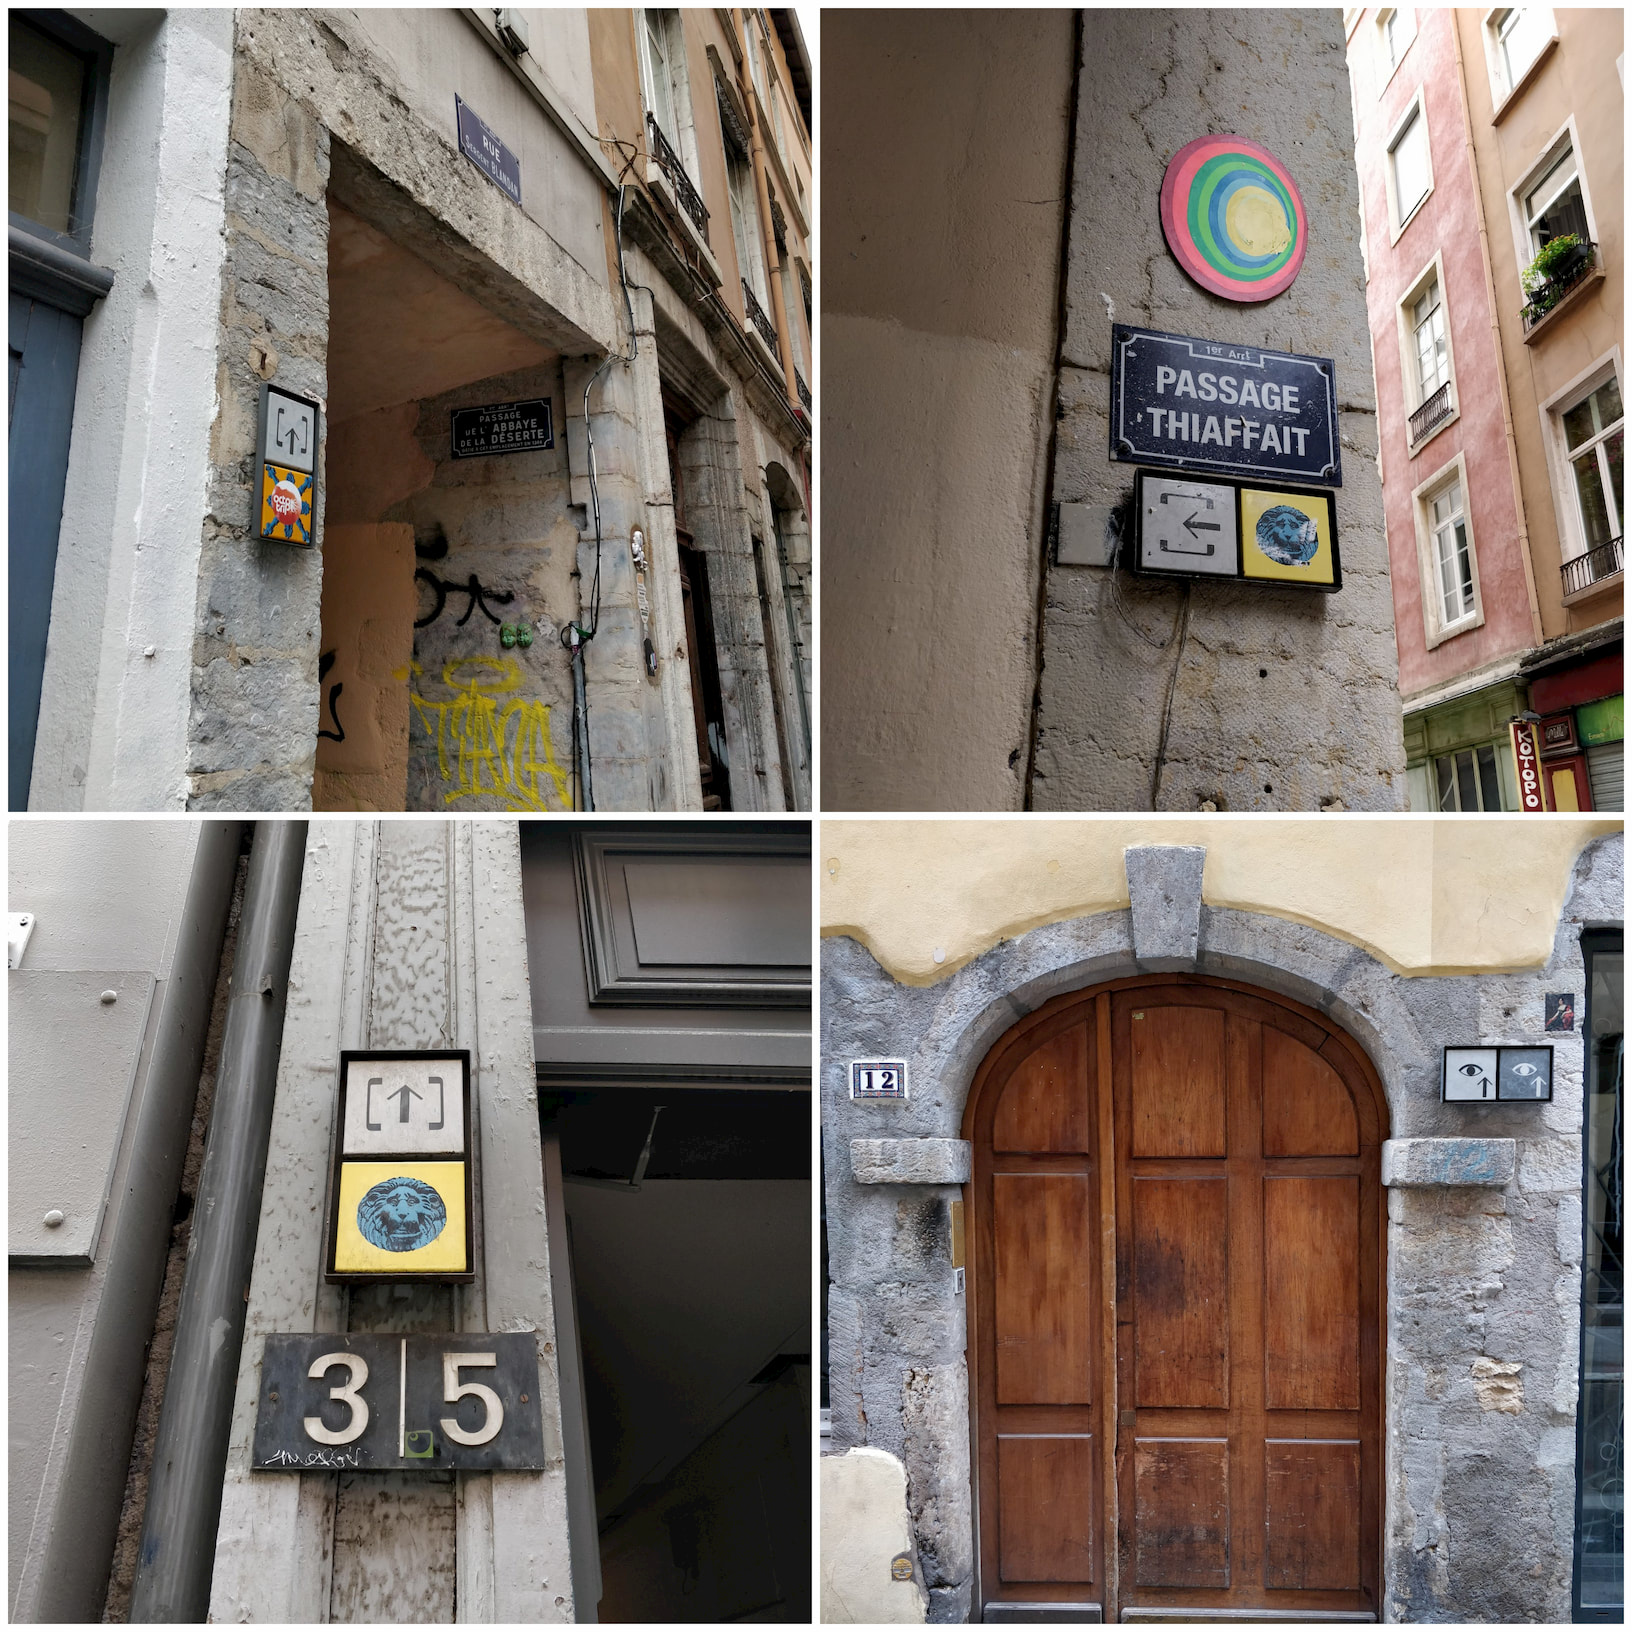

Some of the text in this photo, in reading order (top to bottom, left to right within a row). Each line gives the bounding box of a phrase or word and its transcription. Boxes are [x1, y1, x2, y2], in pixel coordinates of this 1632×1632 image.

[482, 134, 501, 163] RUE
[490, 160, 519, 199] BLANDAN
[1205, 345, 1223, 356] 1er
[1156, 365, 1301, 415] PASSAGE
[479, 411, 521, 423] PASSAGE
[493, 418, 537, 433] ABBAYE
[460, 429, 544, 448] DE LA DÉSERTE
[1146, 406, 1311, 457] THIAFFAIT
[1517, 729, 1539, 808] KOTOPO
[865, 1071, 895, 1090] 12
